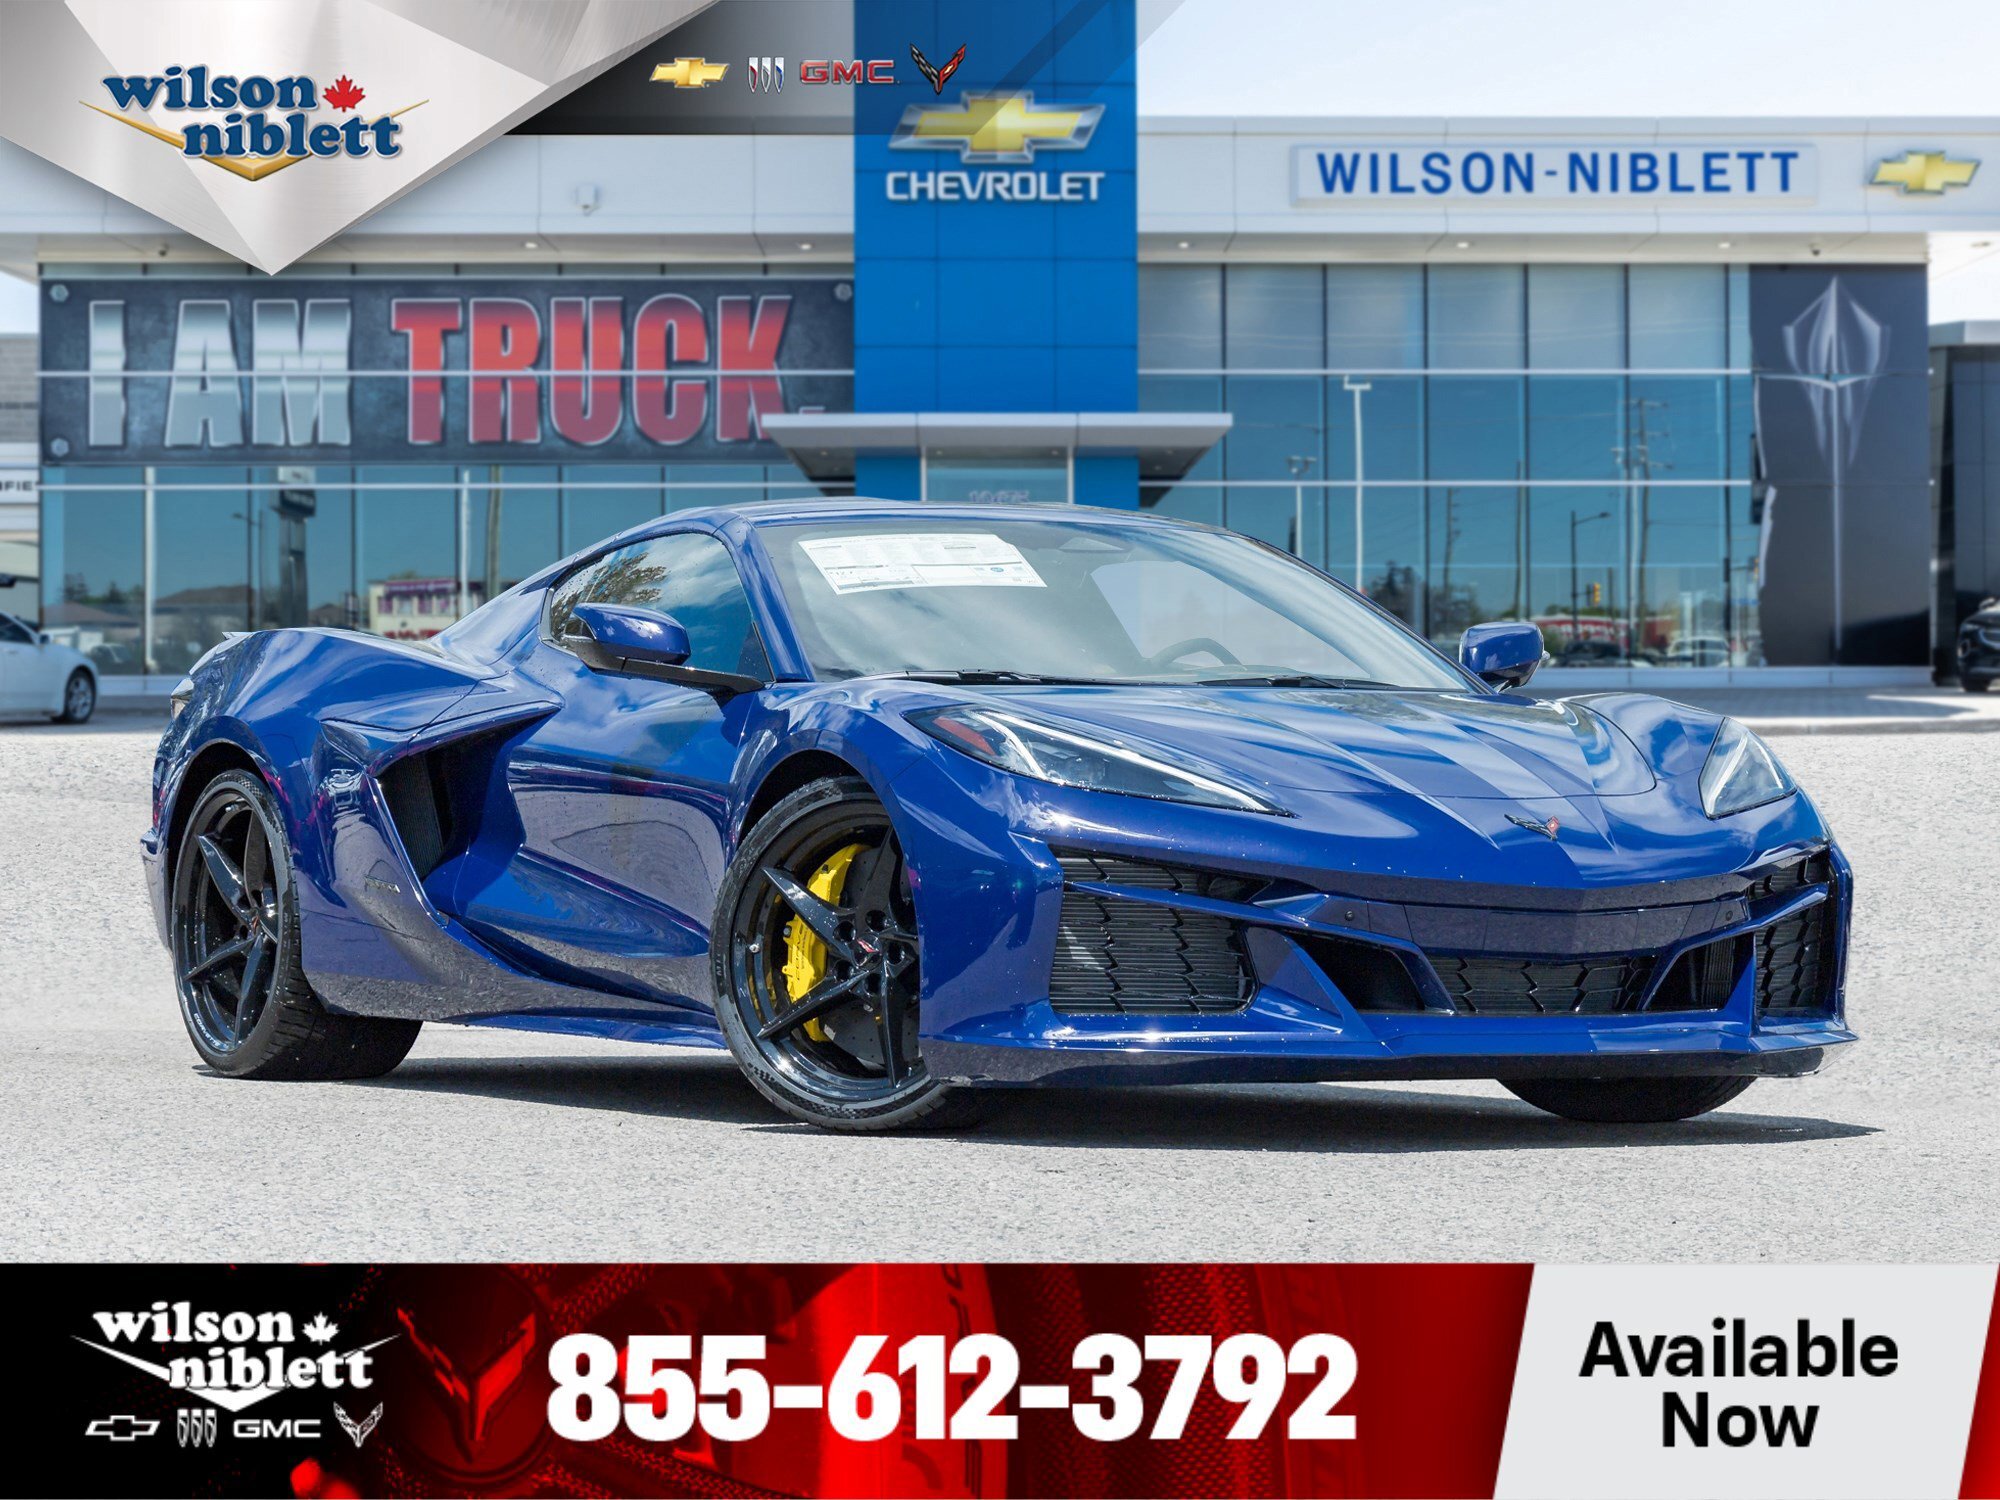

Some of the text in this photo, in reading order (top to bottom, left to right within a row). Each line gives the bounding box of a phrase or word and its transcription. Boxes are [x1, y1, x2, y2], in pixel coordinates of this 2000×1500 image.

[885, 171, 1104, 202] CHEVROLET
[1316, 151, 1799, 194] WILSON-NIBLETT
[88, 294, 826, 447] I AM TRUCK
